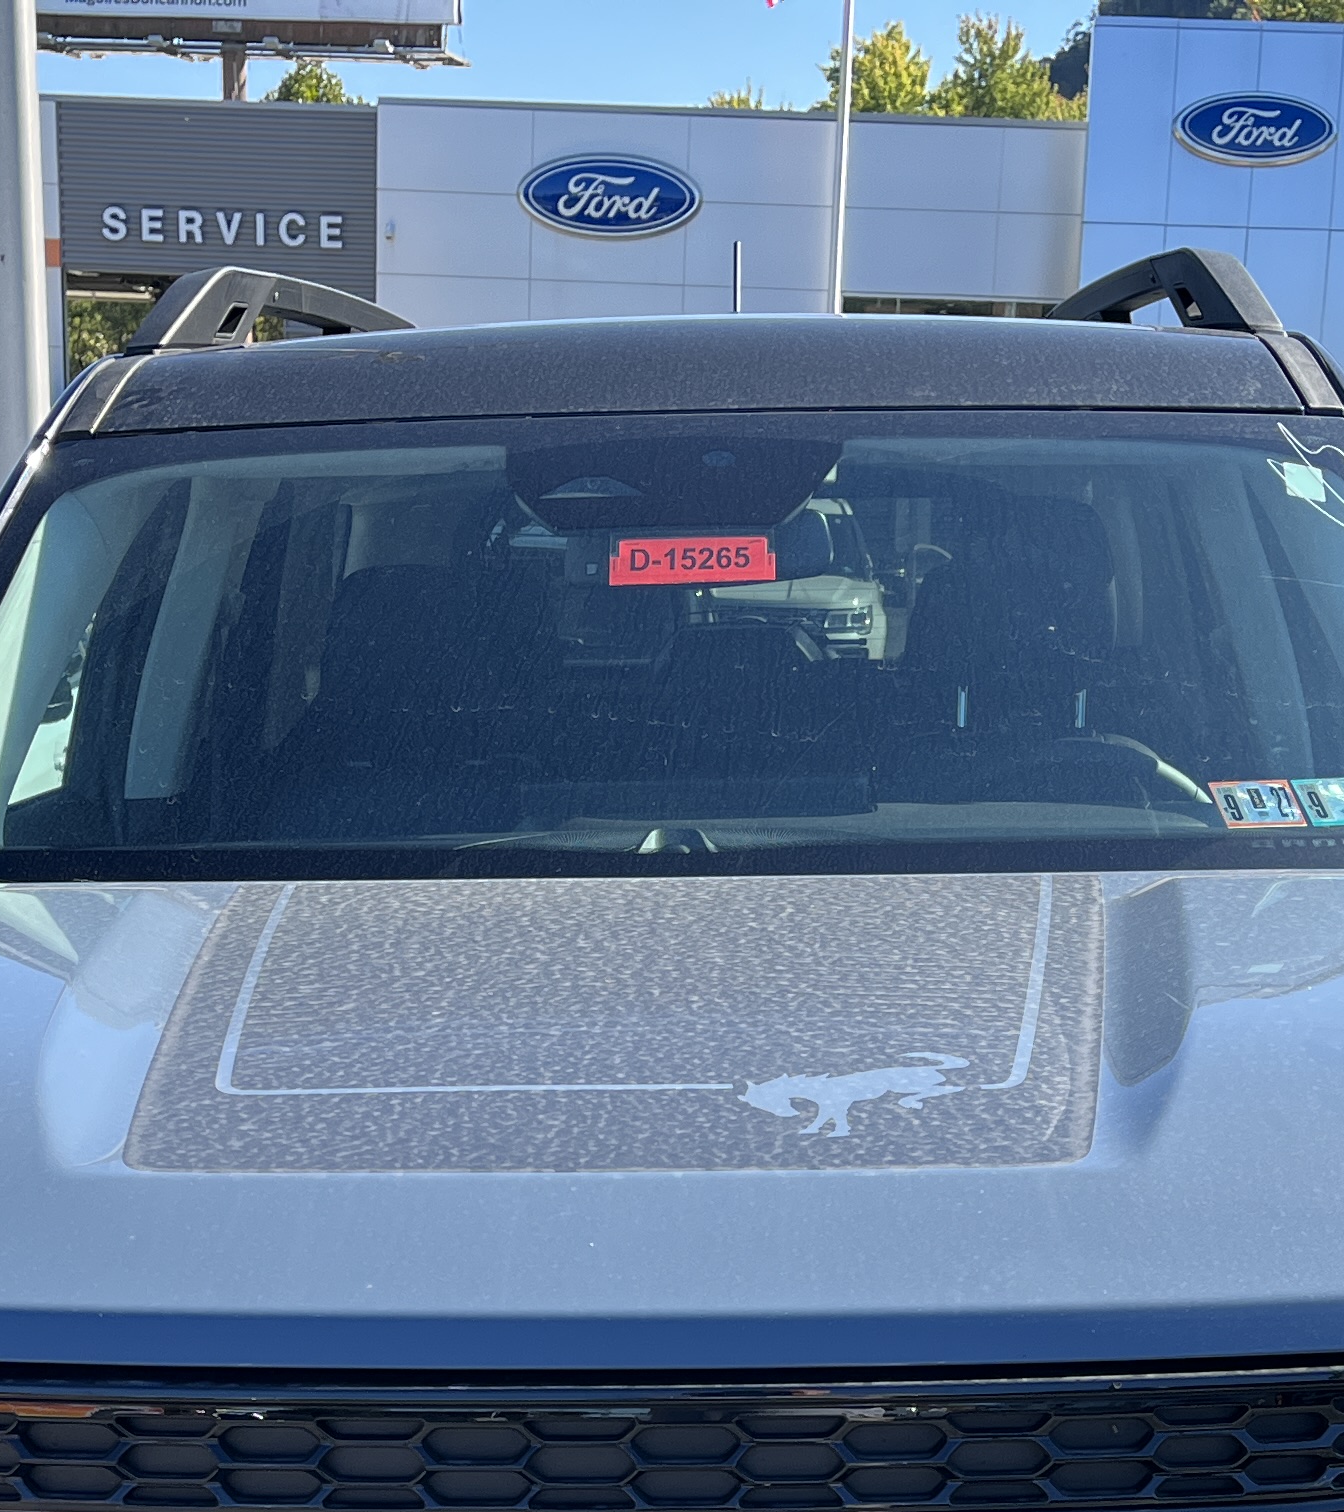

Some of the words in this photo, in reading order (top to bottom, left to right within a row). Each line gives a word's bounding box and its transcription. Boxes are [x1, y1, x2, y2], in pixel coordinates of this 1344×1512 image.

[1211, 106, 1303, 147] Ford
[556, 172, 661, 220] Ford
[101, 205, 343, 249] SERVICE
[629, 546, 751, 572] D-15265
